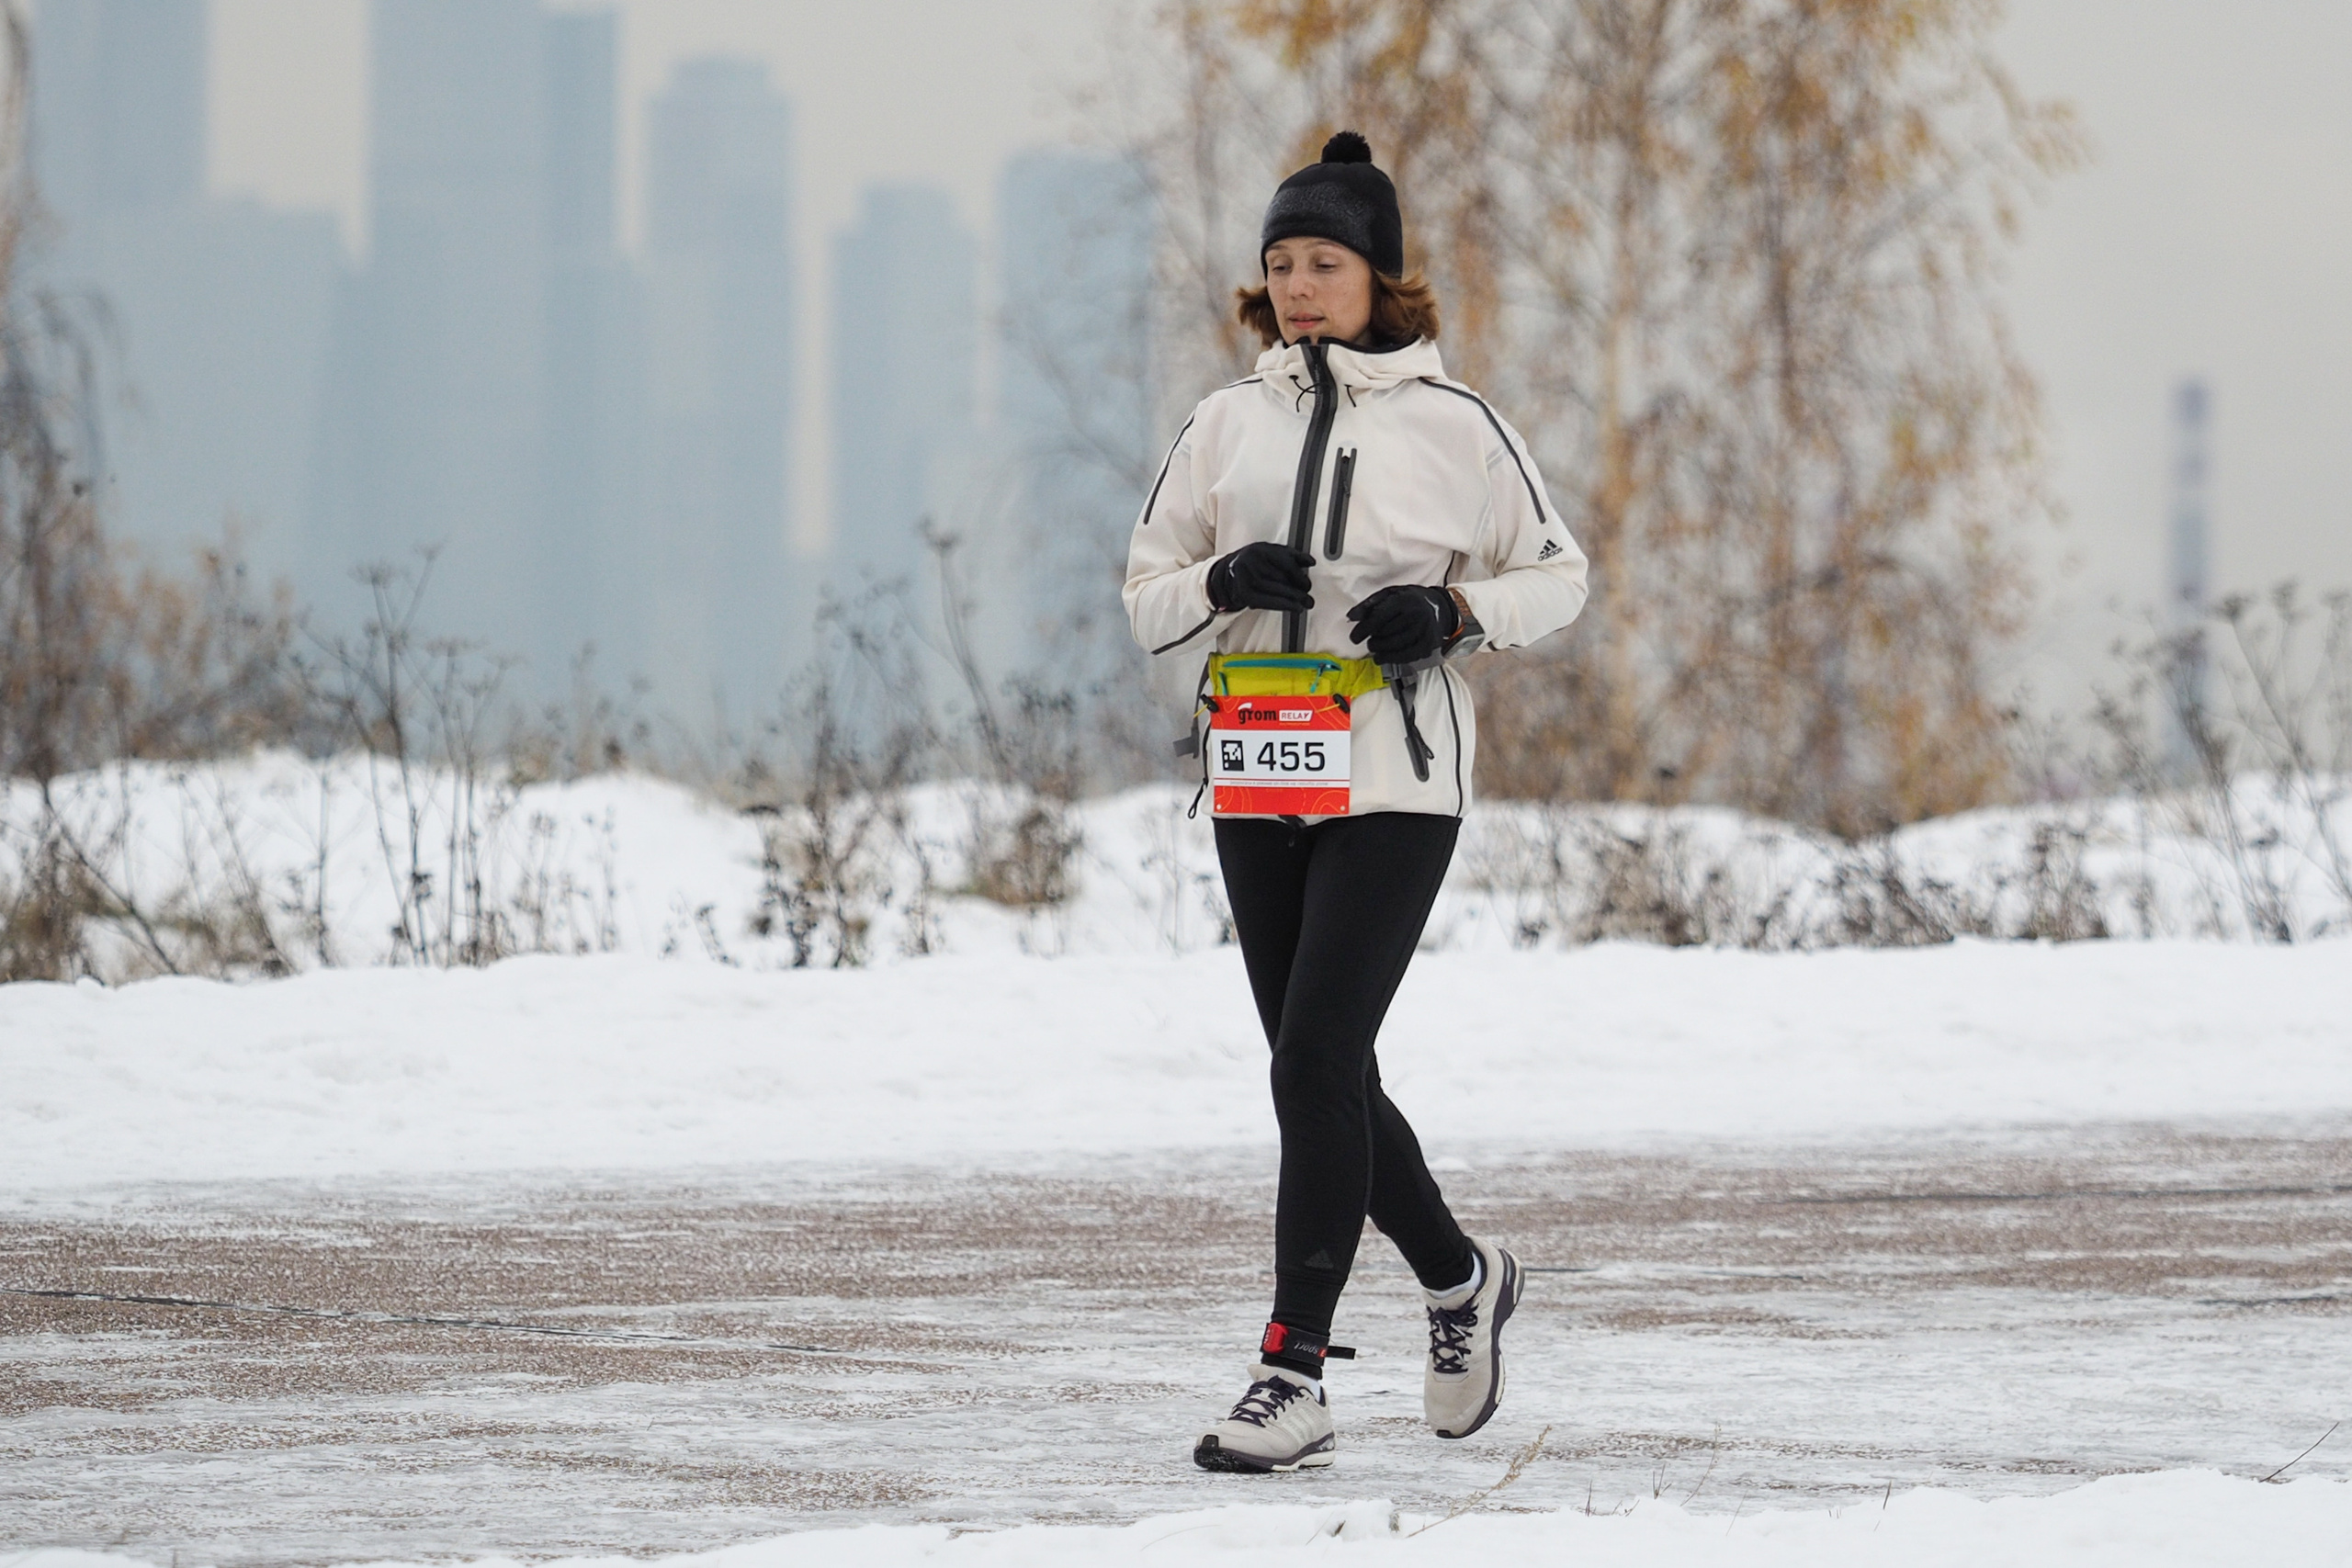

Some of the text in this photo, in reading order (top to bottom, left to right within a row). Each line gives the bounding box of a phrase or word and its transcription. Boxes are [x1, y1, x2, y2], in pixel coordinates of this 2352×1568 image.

[1537, 547, 1563, 562] adidas
[1238, 705, 1310, 725] grom RELAY
[1257, 741, 1326, 772] 455
[1294, 1342, 1318, 1355] sport
